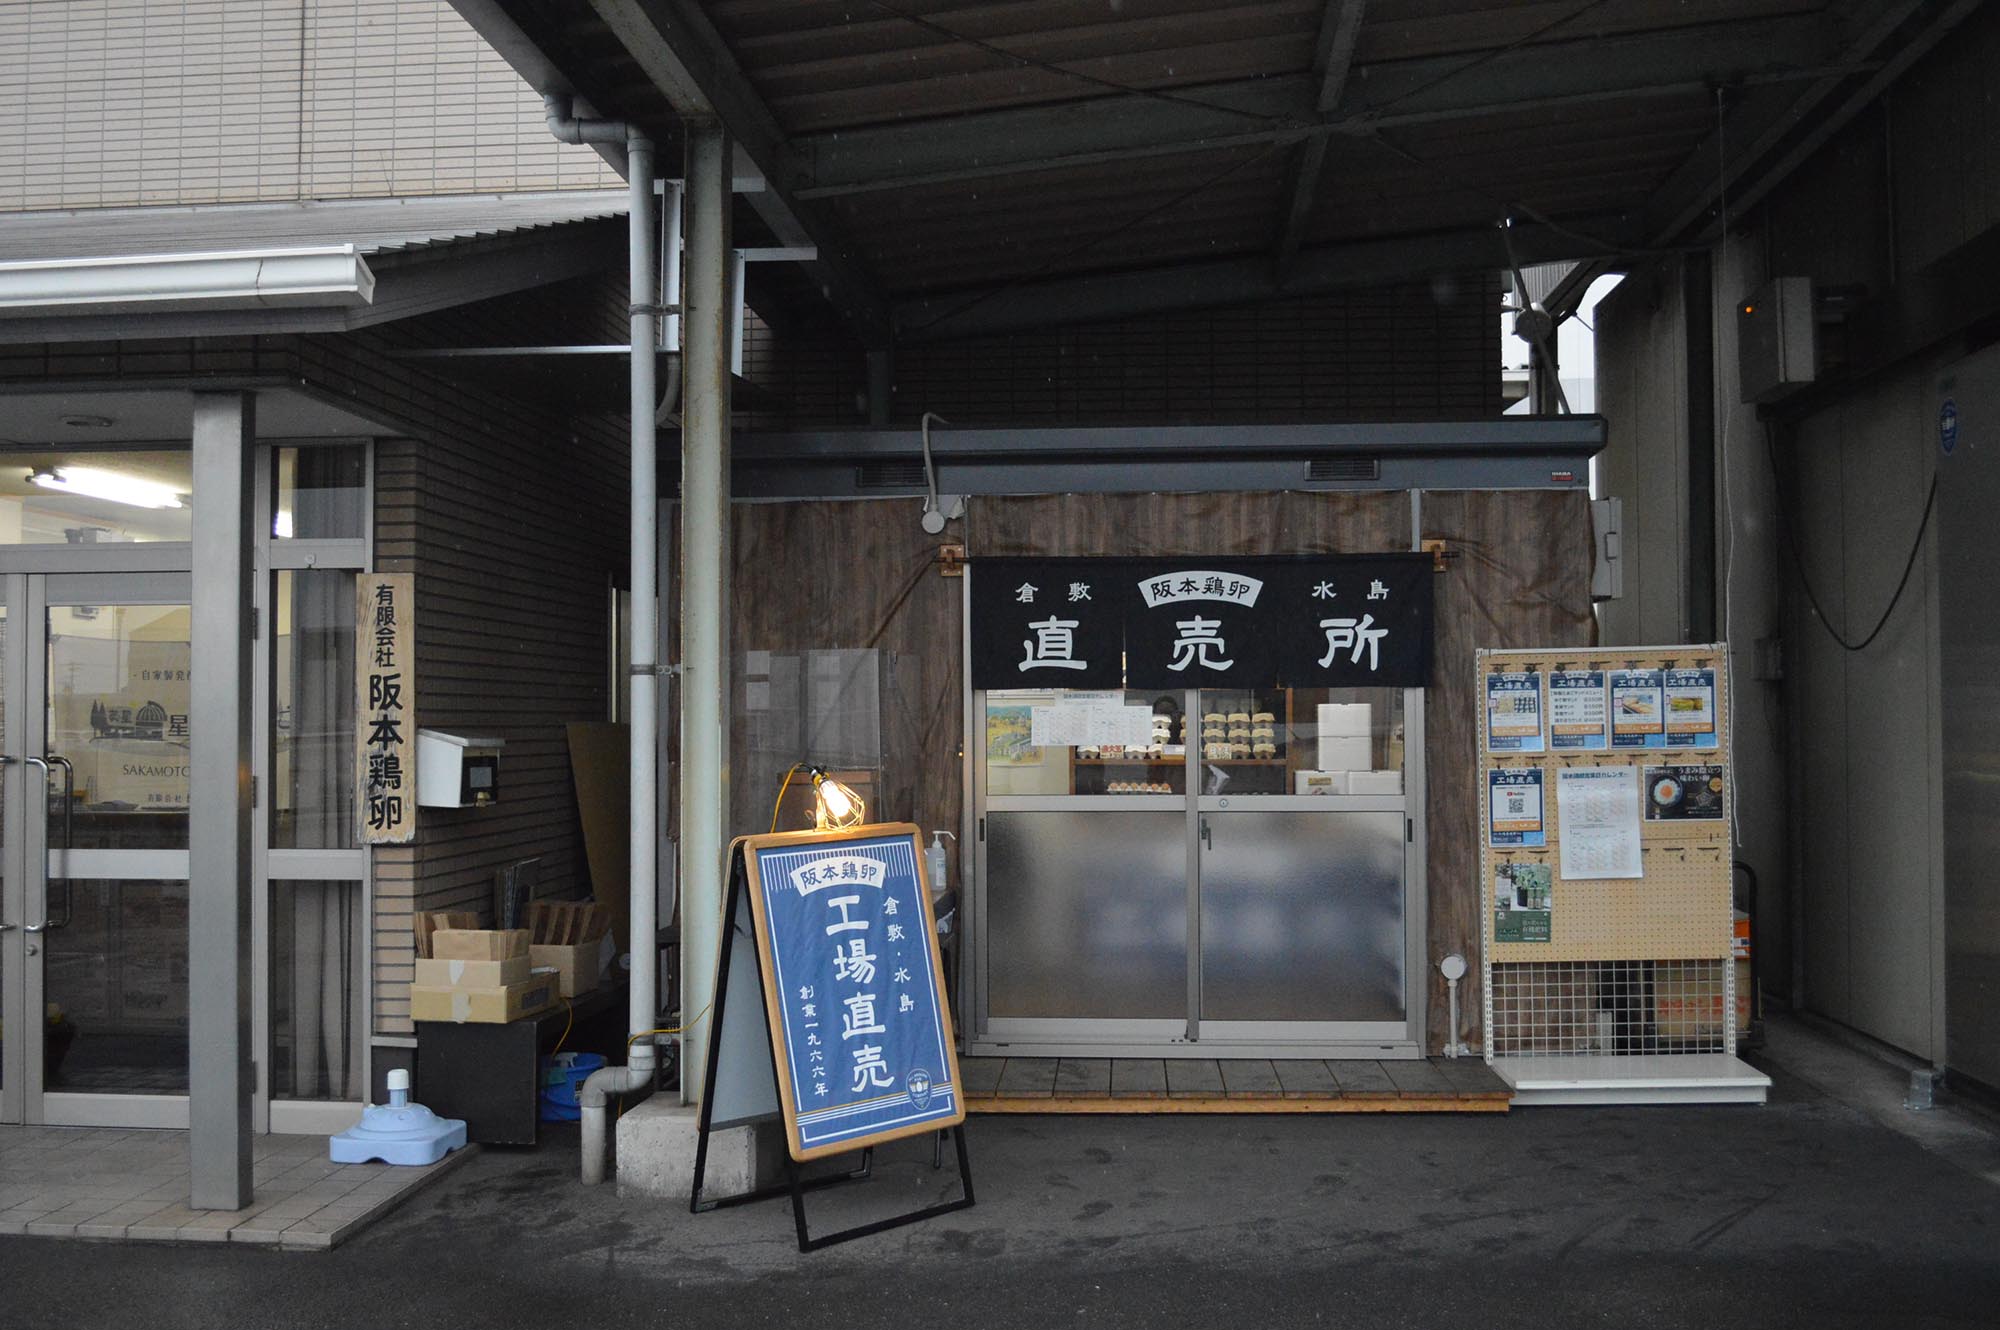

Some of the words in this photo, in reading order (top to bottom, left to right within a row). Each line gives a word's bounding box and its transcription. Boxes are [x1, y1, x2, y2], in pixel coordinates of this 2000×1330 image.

[375, 584, 396, 668] 有限会社
[1150, 577, 1250, 600] 阪本鶏卵
[368, 673, 404, 830] 阪本鶏卵
[800, 861, 878, 890] 阪本鶏卵
[799, 985, 829, 1097] 創業一九六六年
[825, 894, 896, 1093] 工場直売
